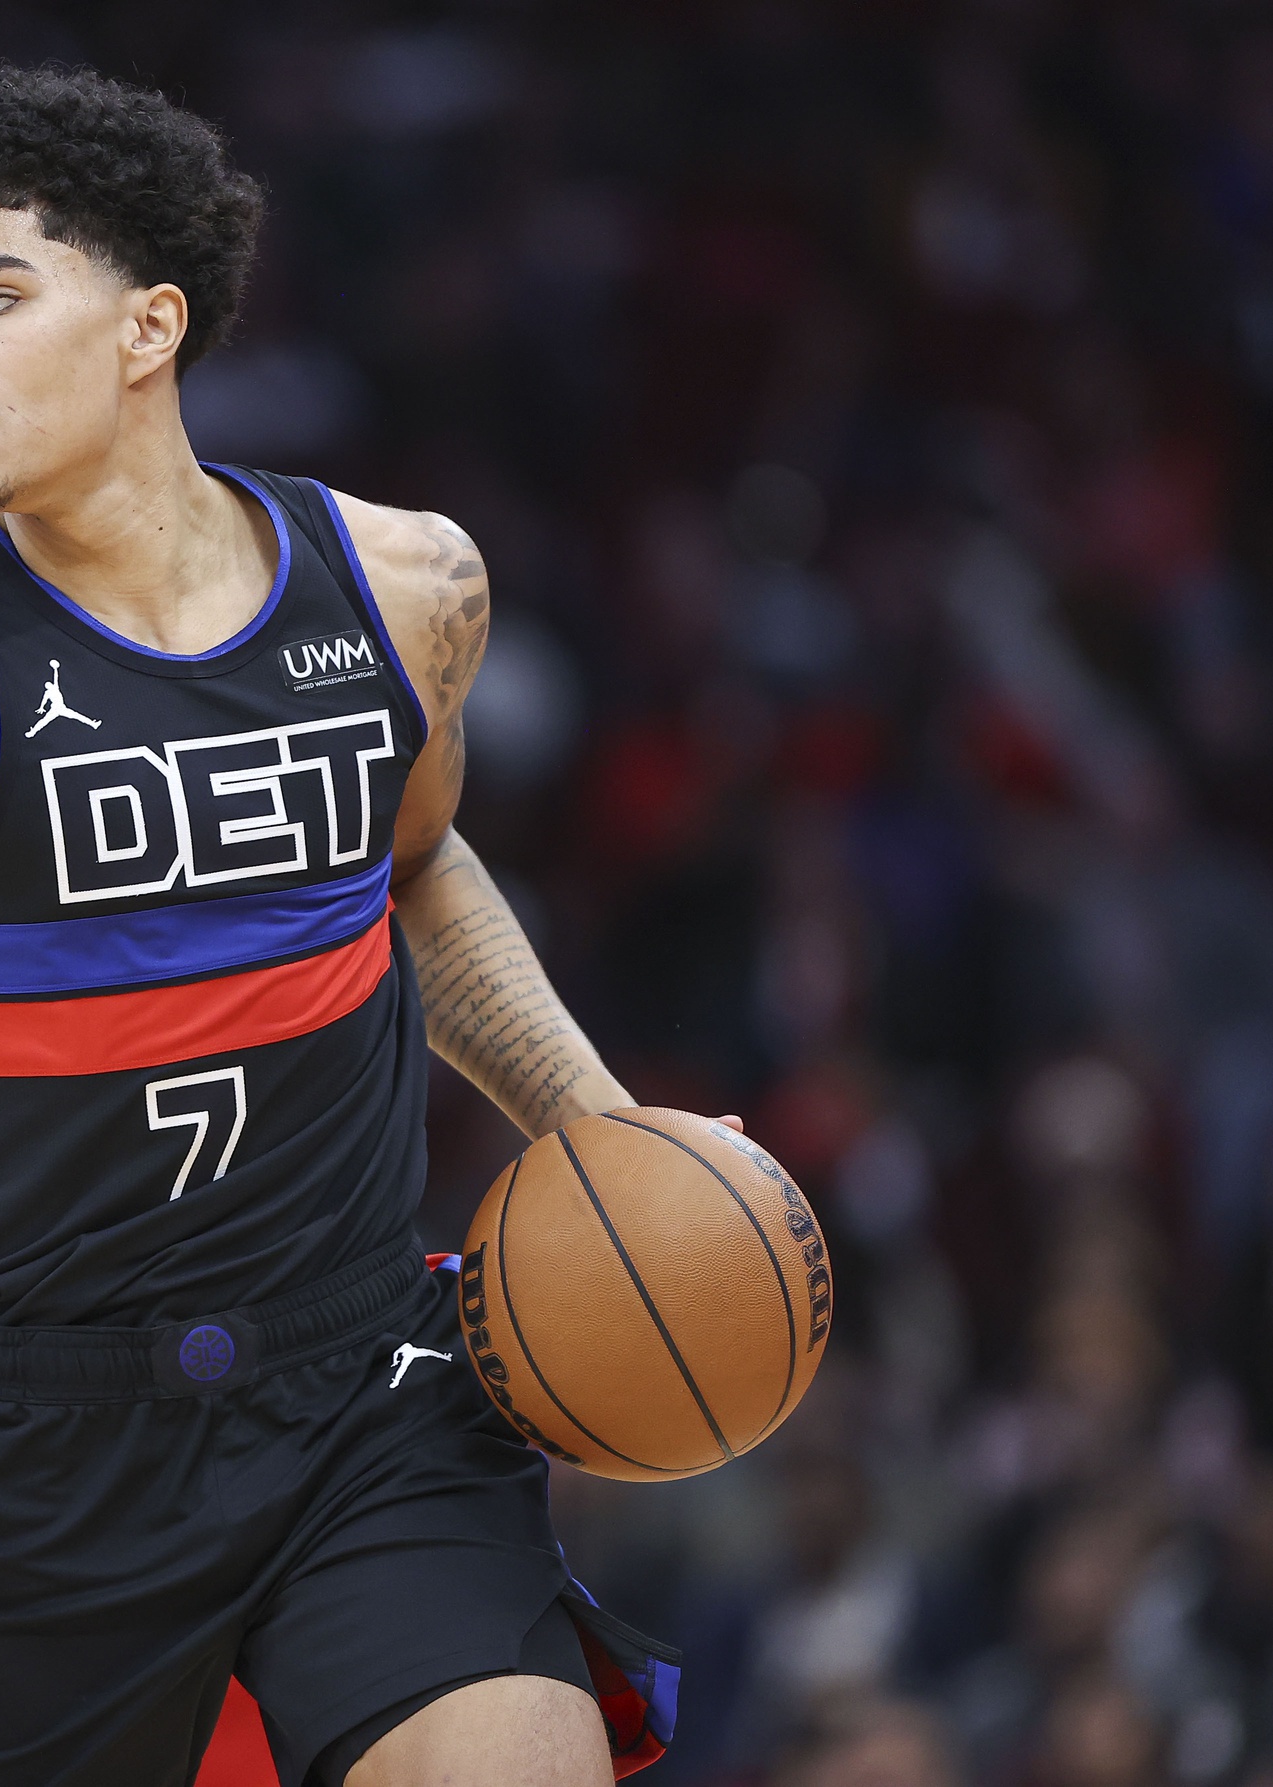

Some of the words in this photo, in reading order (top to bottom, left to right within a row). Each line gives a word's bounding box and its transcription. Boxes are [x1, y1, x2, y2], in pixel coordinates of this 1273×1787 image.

[283, 634, 375, 679] UWM
[294, 684, 314, 692] UNITED
[314, 676, 347, 687] WHOLESALE
[348, 670, 378, 680] MORTGAGE
[40, 708, 396, 905] DET
[145, 1065, 248, 1202] 7
